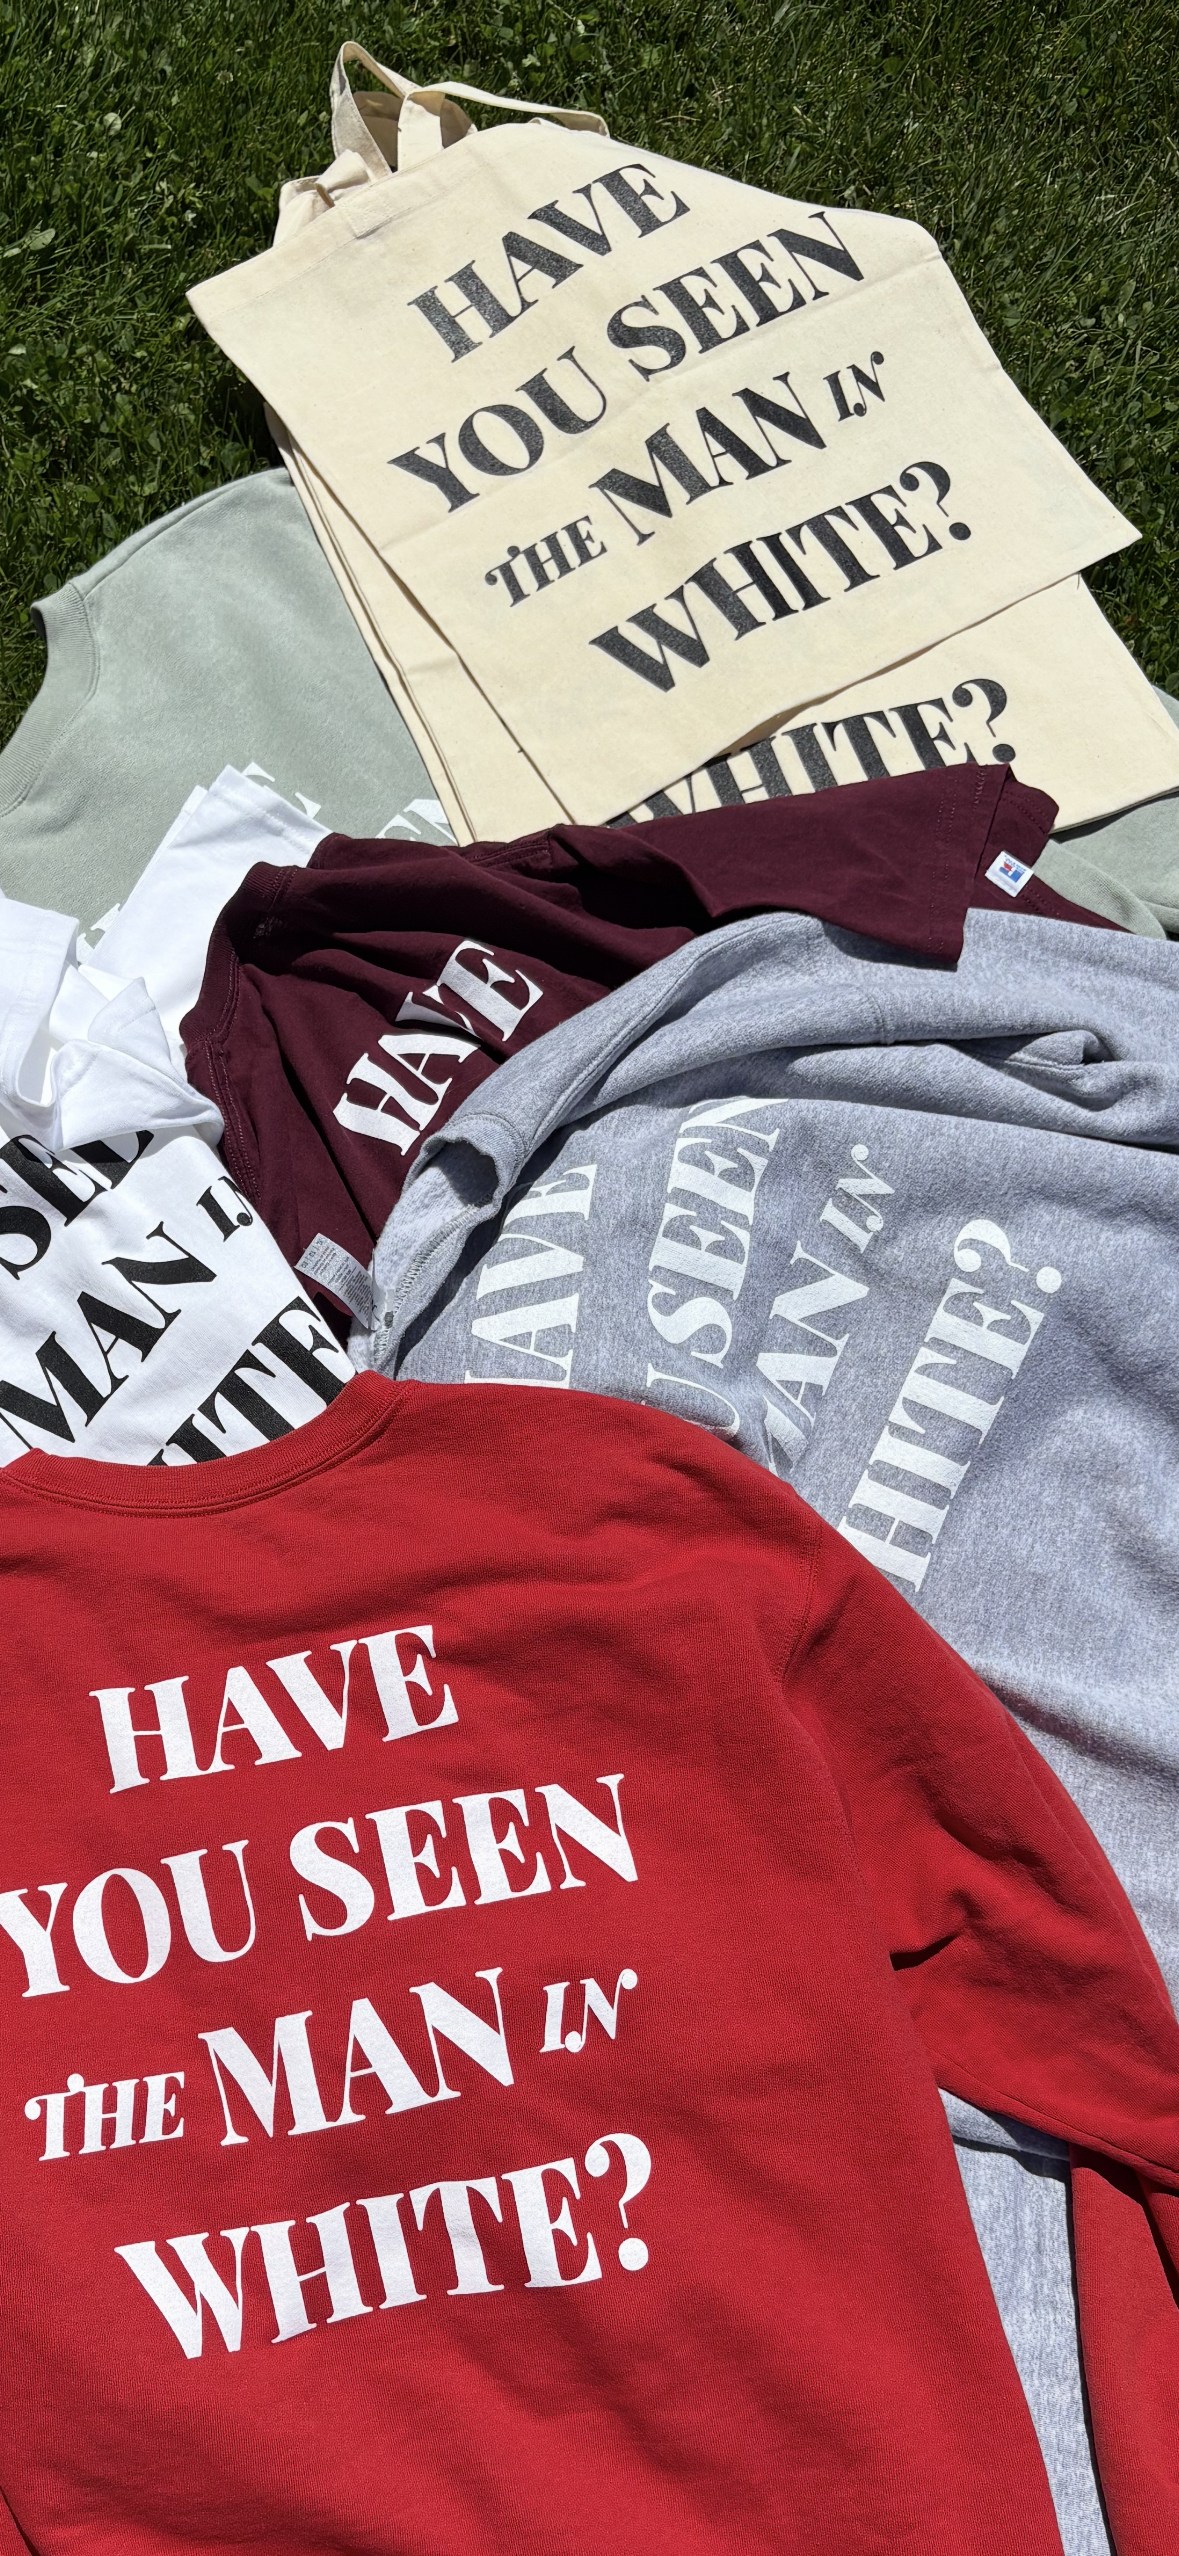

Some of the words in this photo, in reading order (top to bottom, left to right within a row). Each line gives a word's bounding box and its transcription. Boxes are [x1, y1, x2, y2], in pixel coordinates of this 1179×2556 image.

[387, 346, 607, 513] YOU
[607, 211, 865, 382] SEEN
[408, 164, 691, 363] HAVE
[484, 516, 607, 607] THE
[589, 372, 827, 545] MAN
[822, 351, 886, 422] IN
[589, 461, 972, 692] WHITE?
[333, 940, 544, 1156] HAVE
[464, 1164, 598, 1389] AVE
[647, 1099, 789, 1369] SEEN
[820, 1143, 896, 1253] IN
[0, 1222, 217, 1449] MAN
[839, 1218, 1062, 1593] HITE?
[89, 1624, 460, 1794] HAVE
[0, 1840, 257, 1998] YOU
[289, 1773, 639, 1942] SEEN
[24, 2071, 185, 2162] THE
[198, 1966, 515, 2147] MAN
[539, 1968, 638, 2054] IN
[114, 2132, 652, 2360] WHITE?
